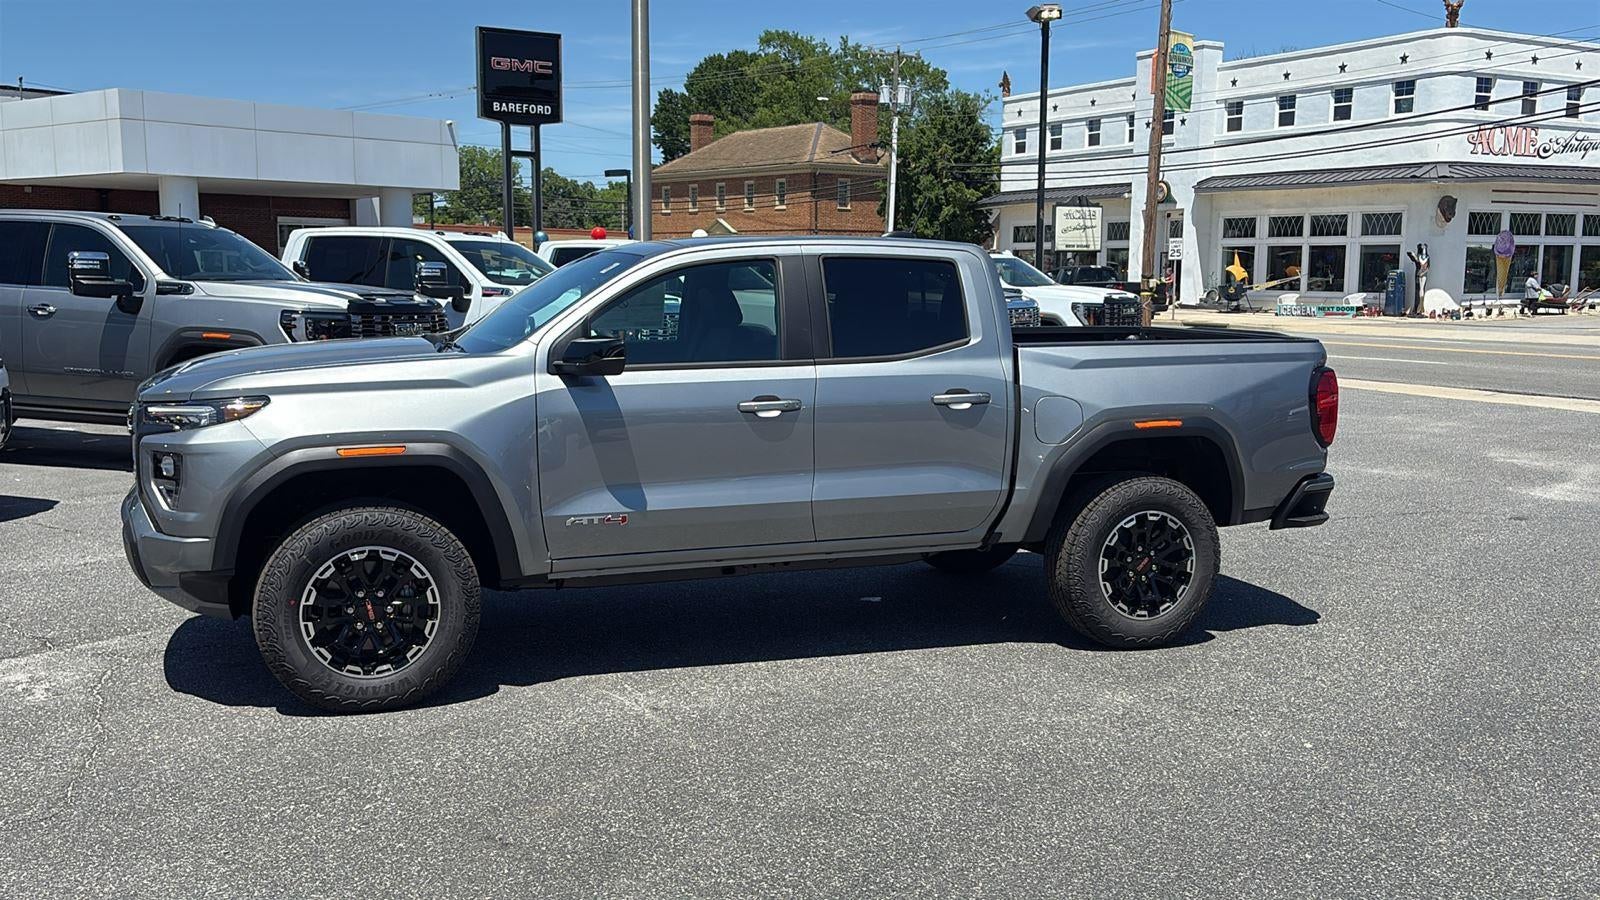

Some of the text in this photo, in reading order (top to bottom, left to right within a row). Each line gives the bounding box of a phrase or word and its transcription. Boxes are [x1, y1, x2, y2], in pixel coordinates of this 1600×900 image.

[491, 56, 553, 75] GMC
[492, 101, 552, 115] BAREFORD
[1467, 124, 1539, 157] ACME
[1170, 249, 1181, 257] 25
[1280, 306, 1317, 316] ICE CREAM
[565, 514, 628, 526] AT4
